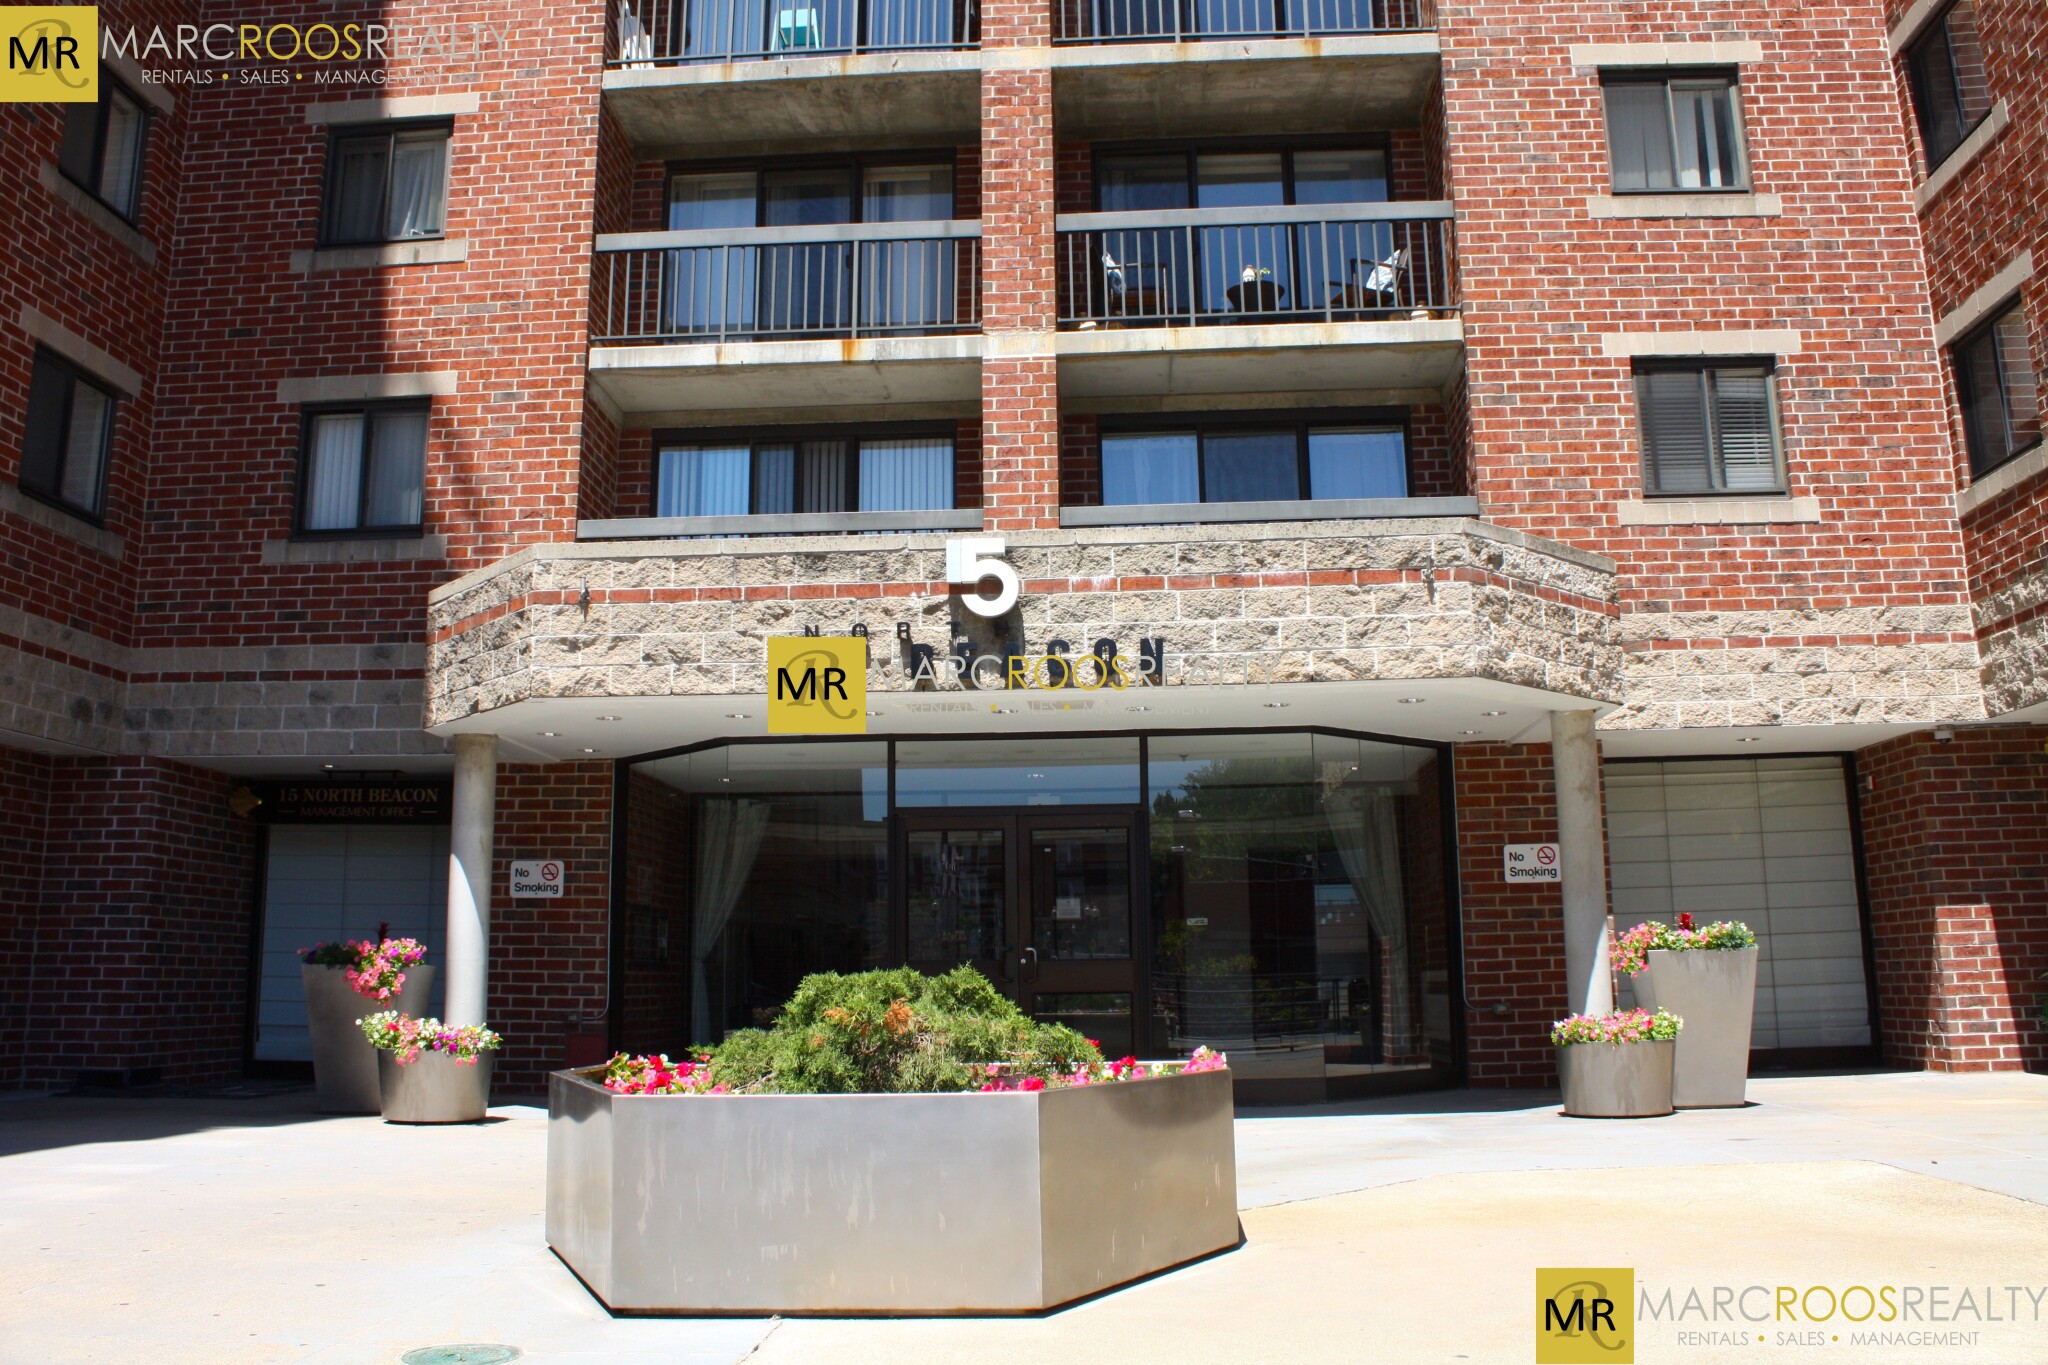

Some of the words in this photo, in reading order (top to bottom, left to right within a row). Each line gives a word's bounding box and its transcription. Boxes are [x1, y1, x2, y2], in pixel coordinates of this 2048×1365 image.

[279, 788, 298, 802] 15
[303, 788, 363, 803] NORTH
[368, 788, 439, 803] BEACON
[301, 806, 377, 817] MANAGEMENT
[380, 806, 415, 817] OFFICE
[1509, 852, 1525, 862] No
[515, 868, 530, 877] No
[1509, 867, 1557, 878] Smoking
[514, 882, 559, 895] Smoking
